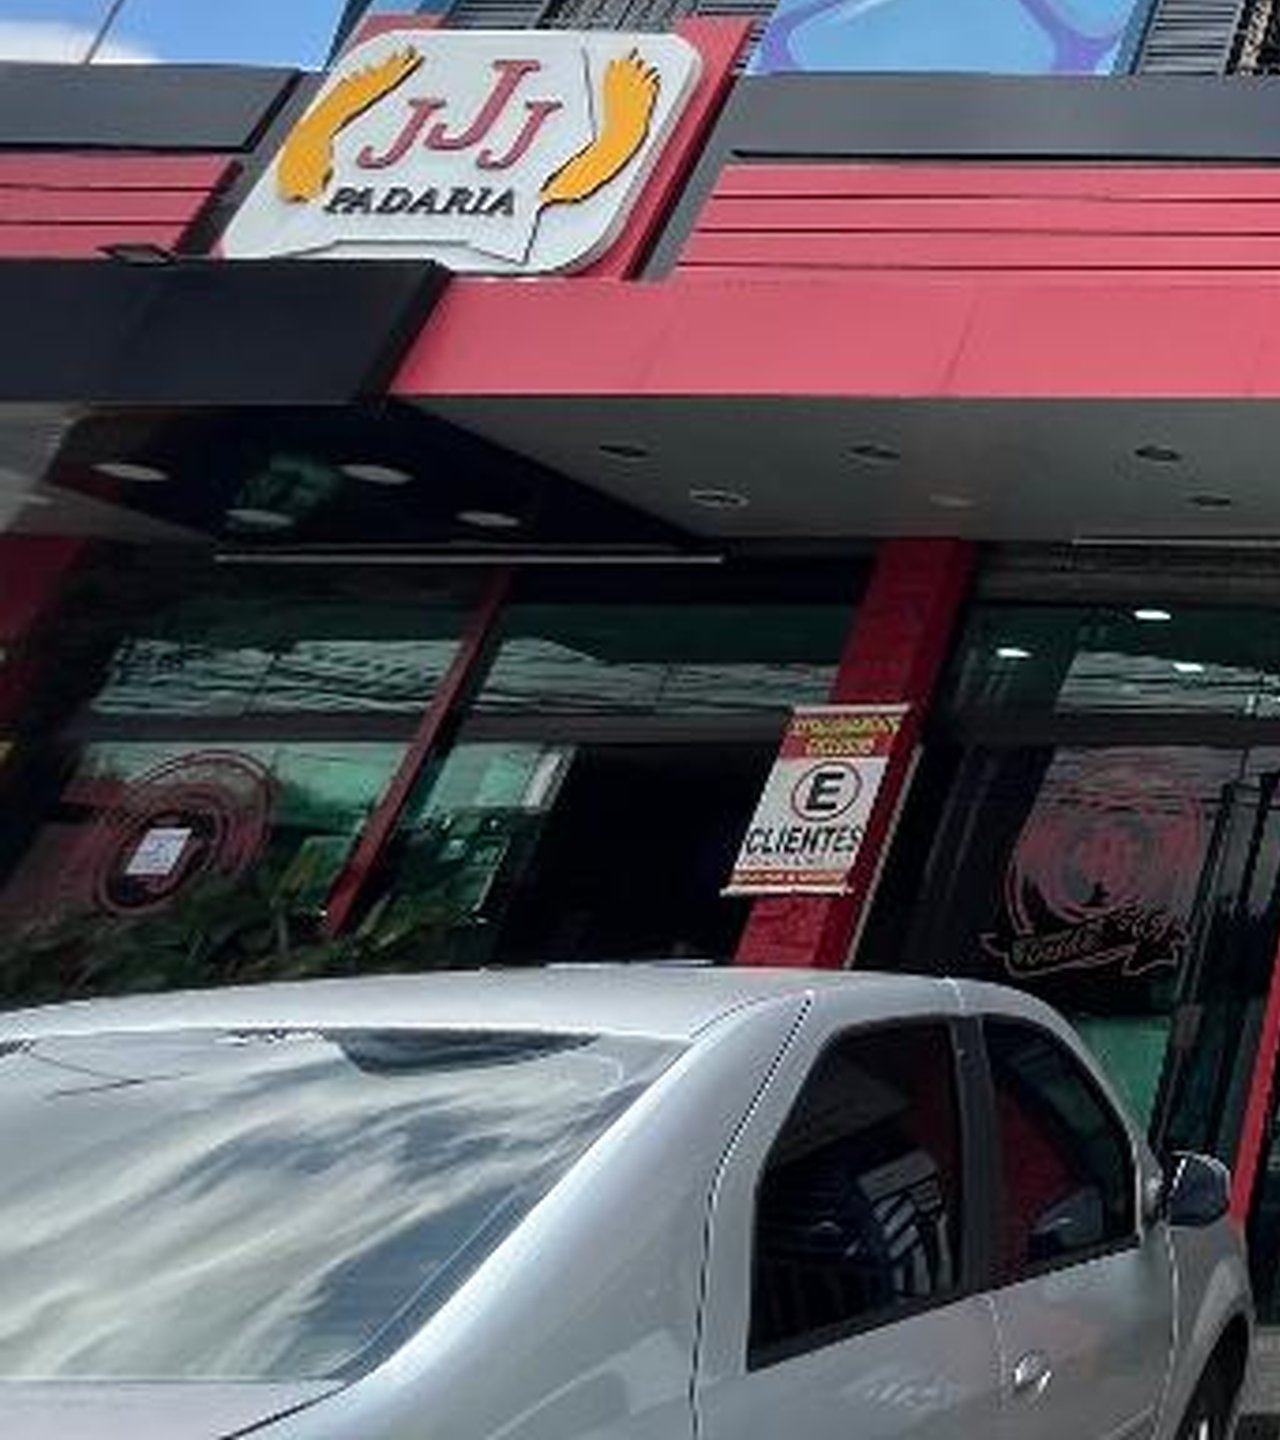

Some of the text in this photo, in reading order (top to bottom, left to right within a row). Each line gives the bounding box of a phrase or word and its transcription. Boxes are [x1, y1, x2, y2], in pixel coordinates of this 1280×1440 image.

[356, 59, 563, 169] JJJ
[323, 186, 517, 217] PADARIA
[805, 772, 846, 810] E
[746, 827, 862, 854] CLIENTES
